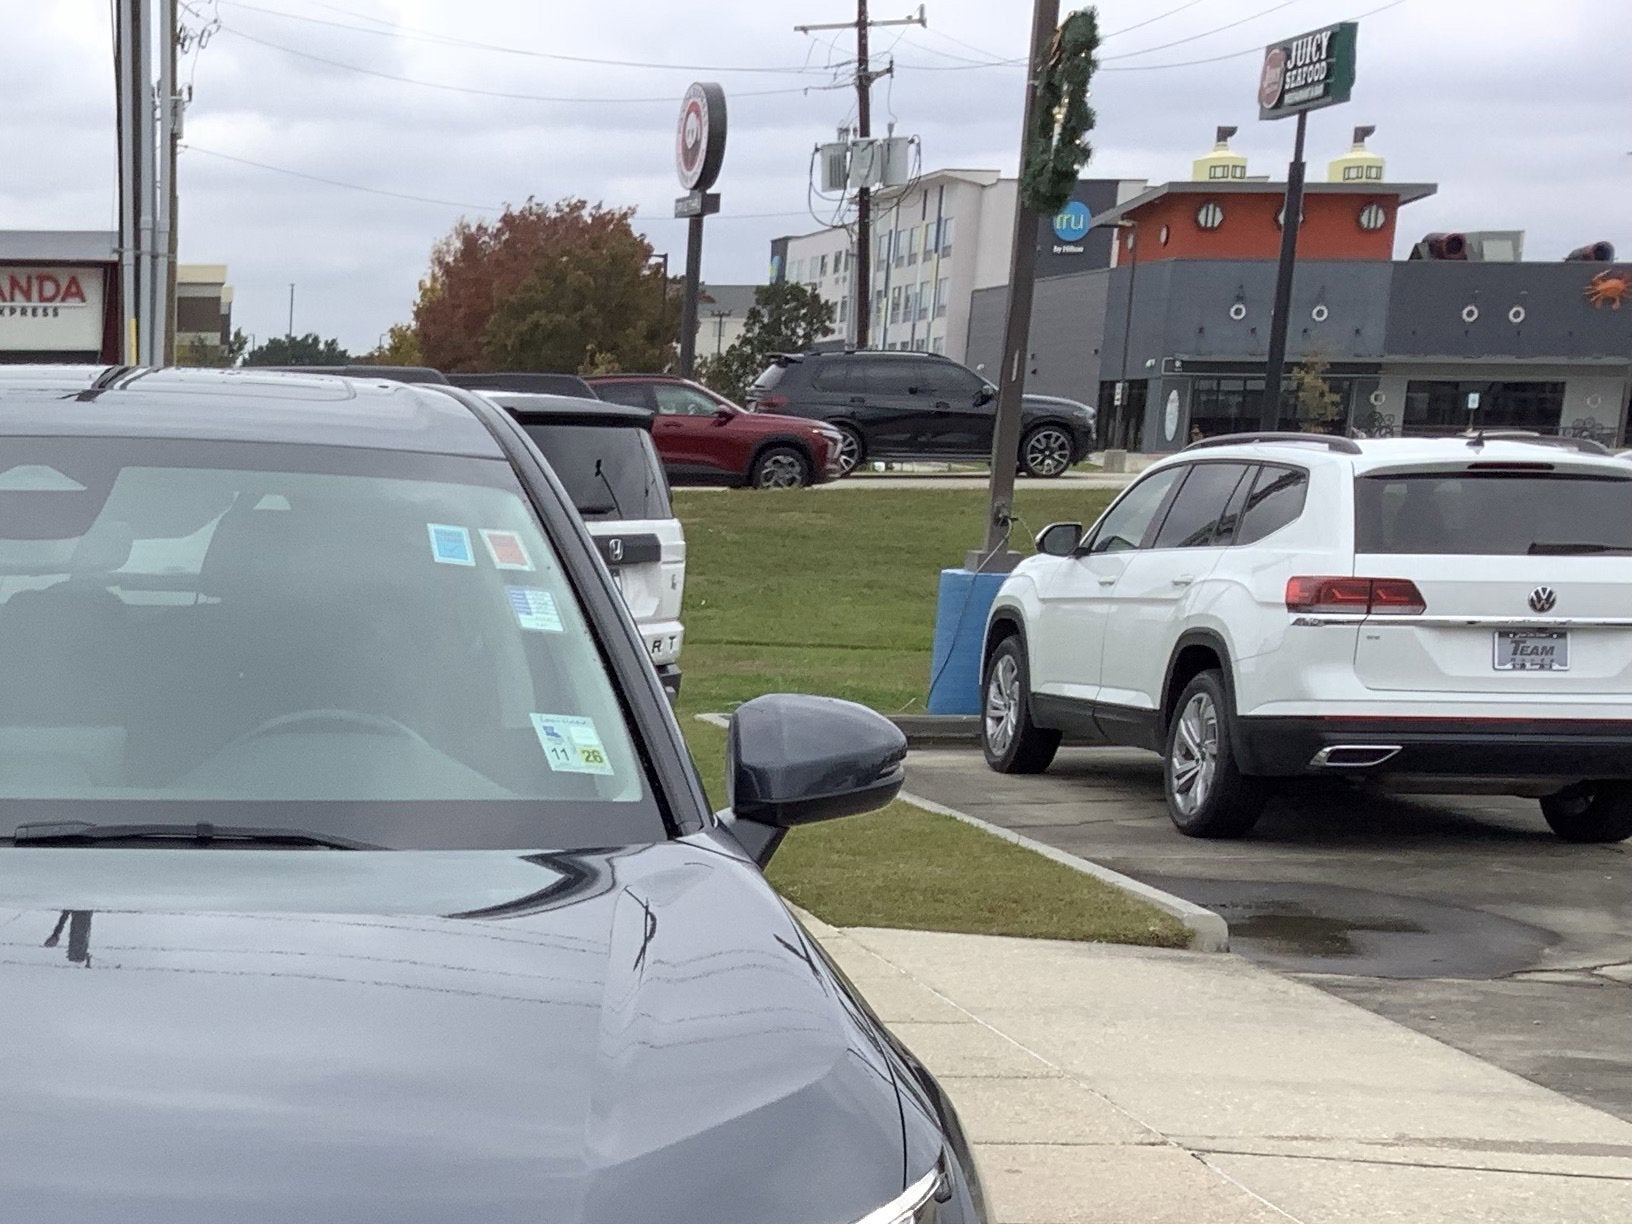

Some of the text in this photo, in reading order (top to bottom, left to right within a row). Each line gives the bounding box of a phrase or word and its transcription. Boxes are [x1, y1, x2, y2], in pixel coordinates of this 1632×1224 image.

[1287, 30, 1331, 69] JUICY
[1285, 61, 1327, 89] SEAFOOD
[551, 747, 604, 763] 11 26
